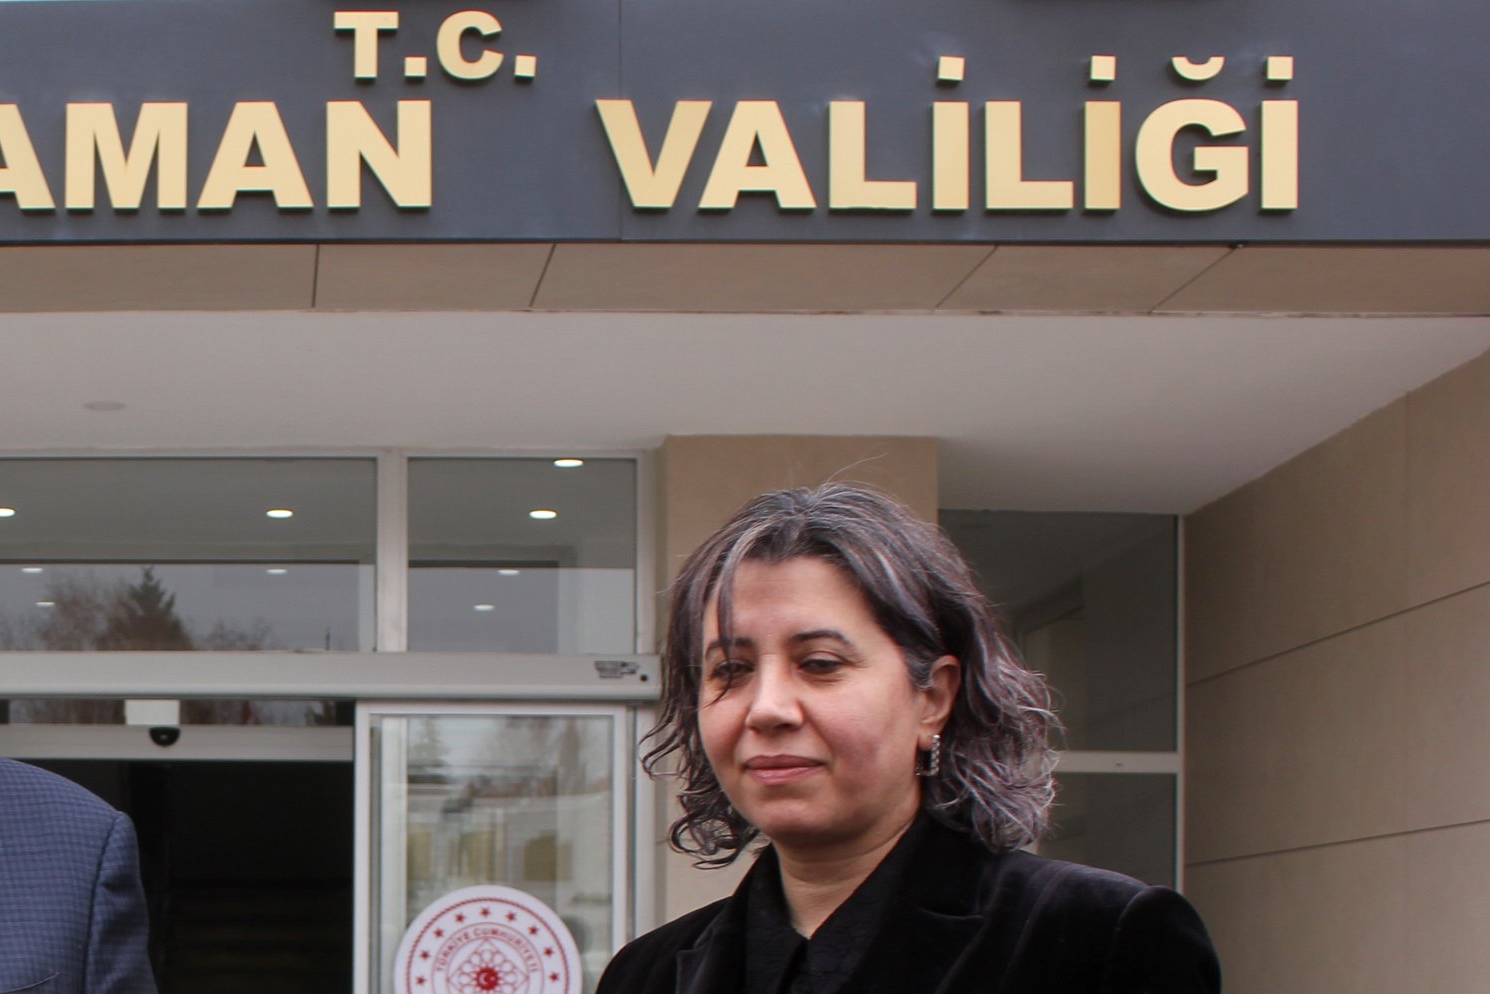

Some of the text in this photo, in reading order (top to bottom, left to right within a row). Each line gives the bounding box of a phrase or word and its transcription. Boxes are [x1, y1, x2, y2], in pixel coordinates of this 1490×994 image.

[333, 10, 538, 81] T.C.
[594, 55, 1299, 213] VALİLİĞİ
[436, 932, 471, 972] TÜRKİYE
